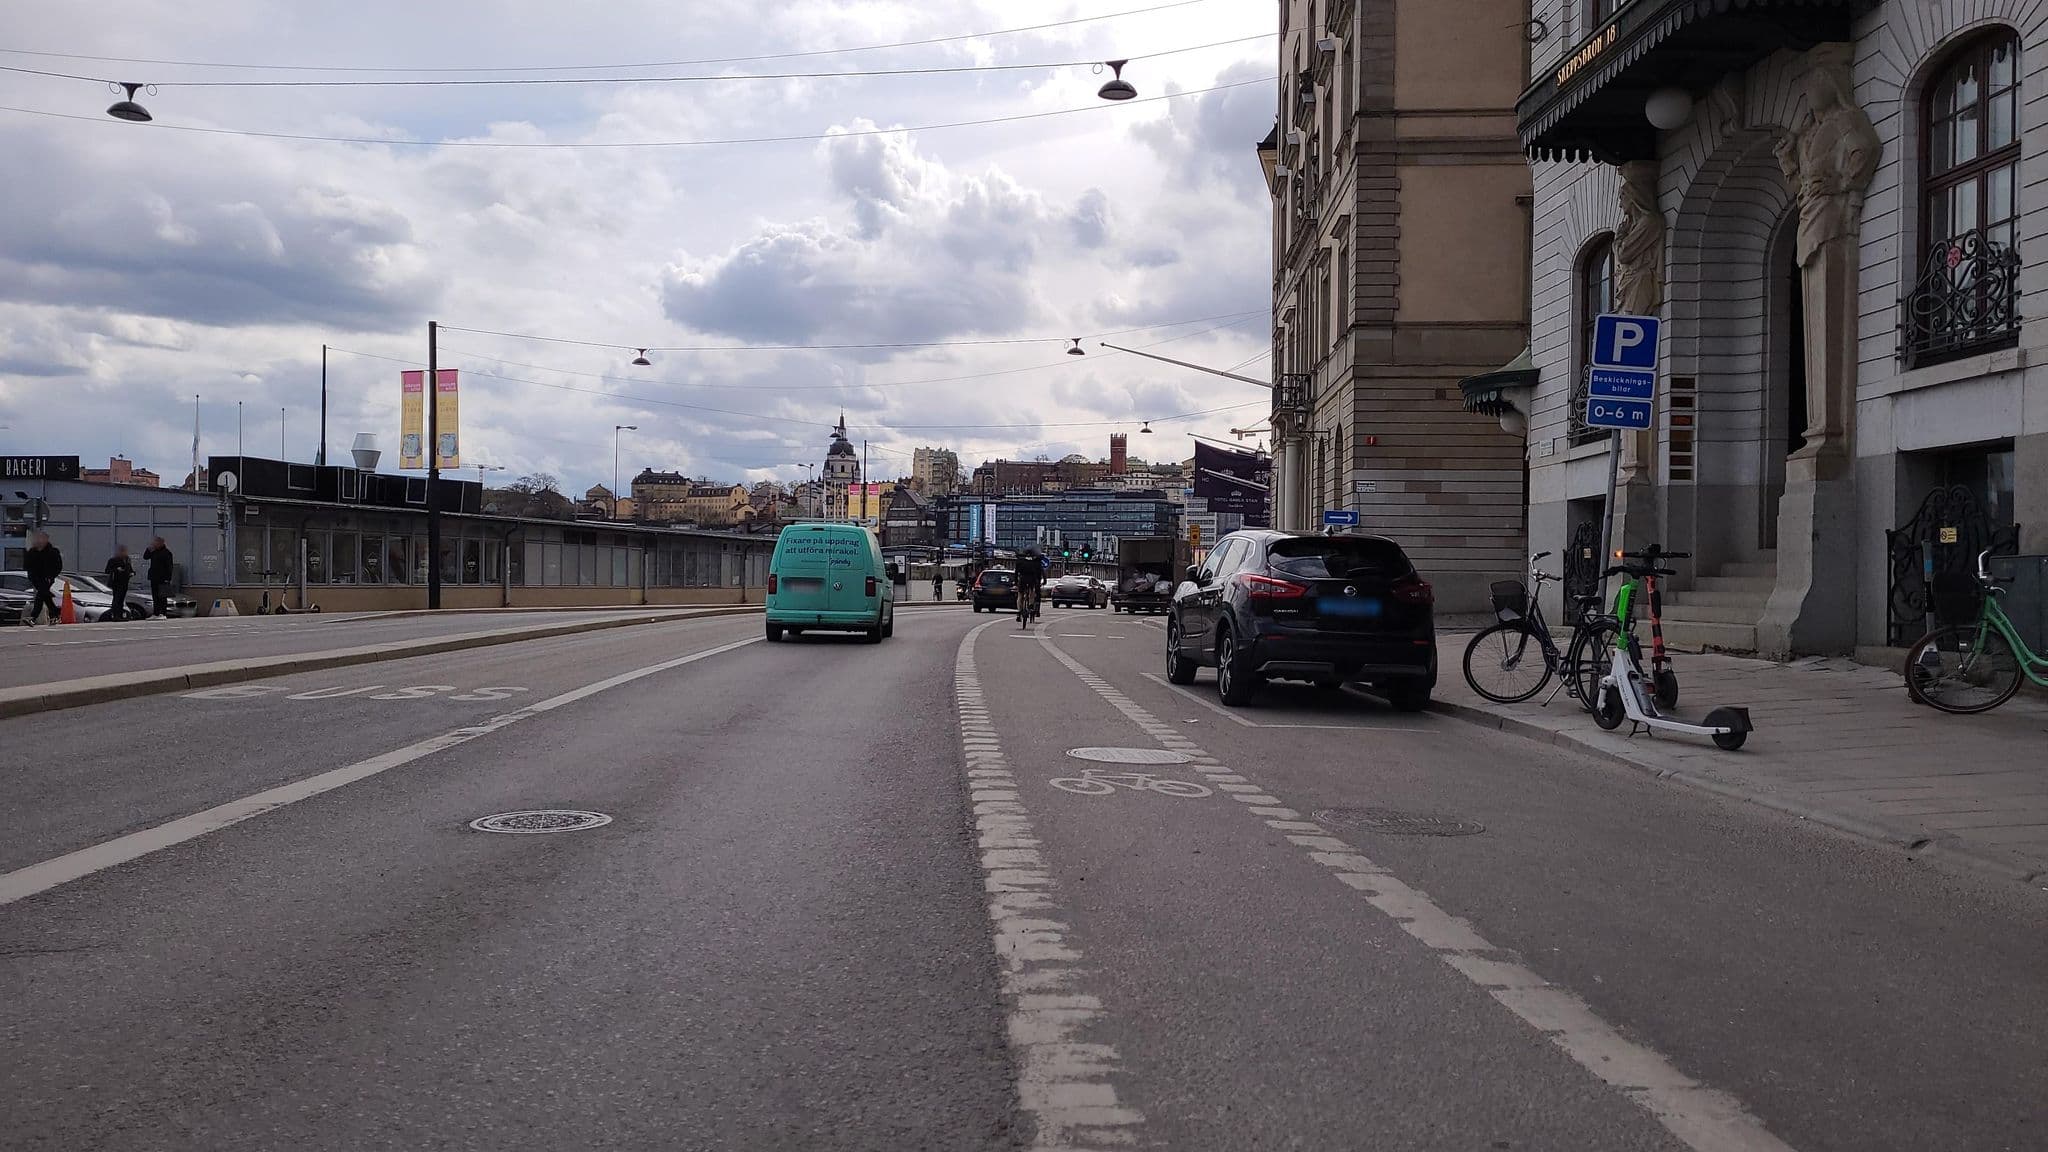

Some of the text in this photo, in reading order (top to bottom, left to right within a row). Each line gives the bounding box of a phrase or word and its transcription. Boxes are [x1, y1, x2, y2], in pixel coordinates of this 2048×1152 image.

[1557, 24, 1616, 86] SKEPPSBRON 18
[1612, 322, 1645, 362] P
[1593, 375, 1652, 387] Beskicknings-
[1611, 385, 1631, 393] bilar
[1594, 405, 1644, 420] 0-6 m
[6, 458, 46, 476] BAGERI
[786, 537, 860, 548] Fixare på uppdrag
